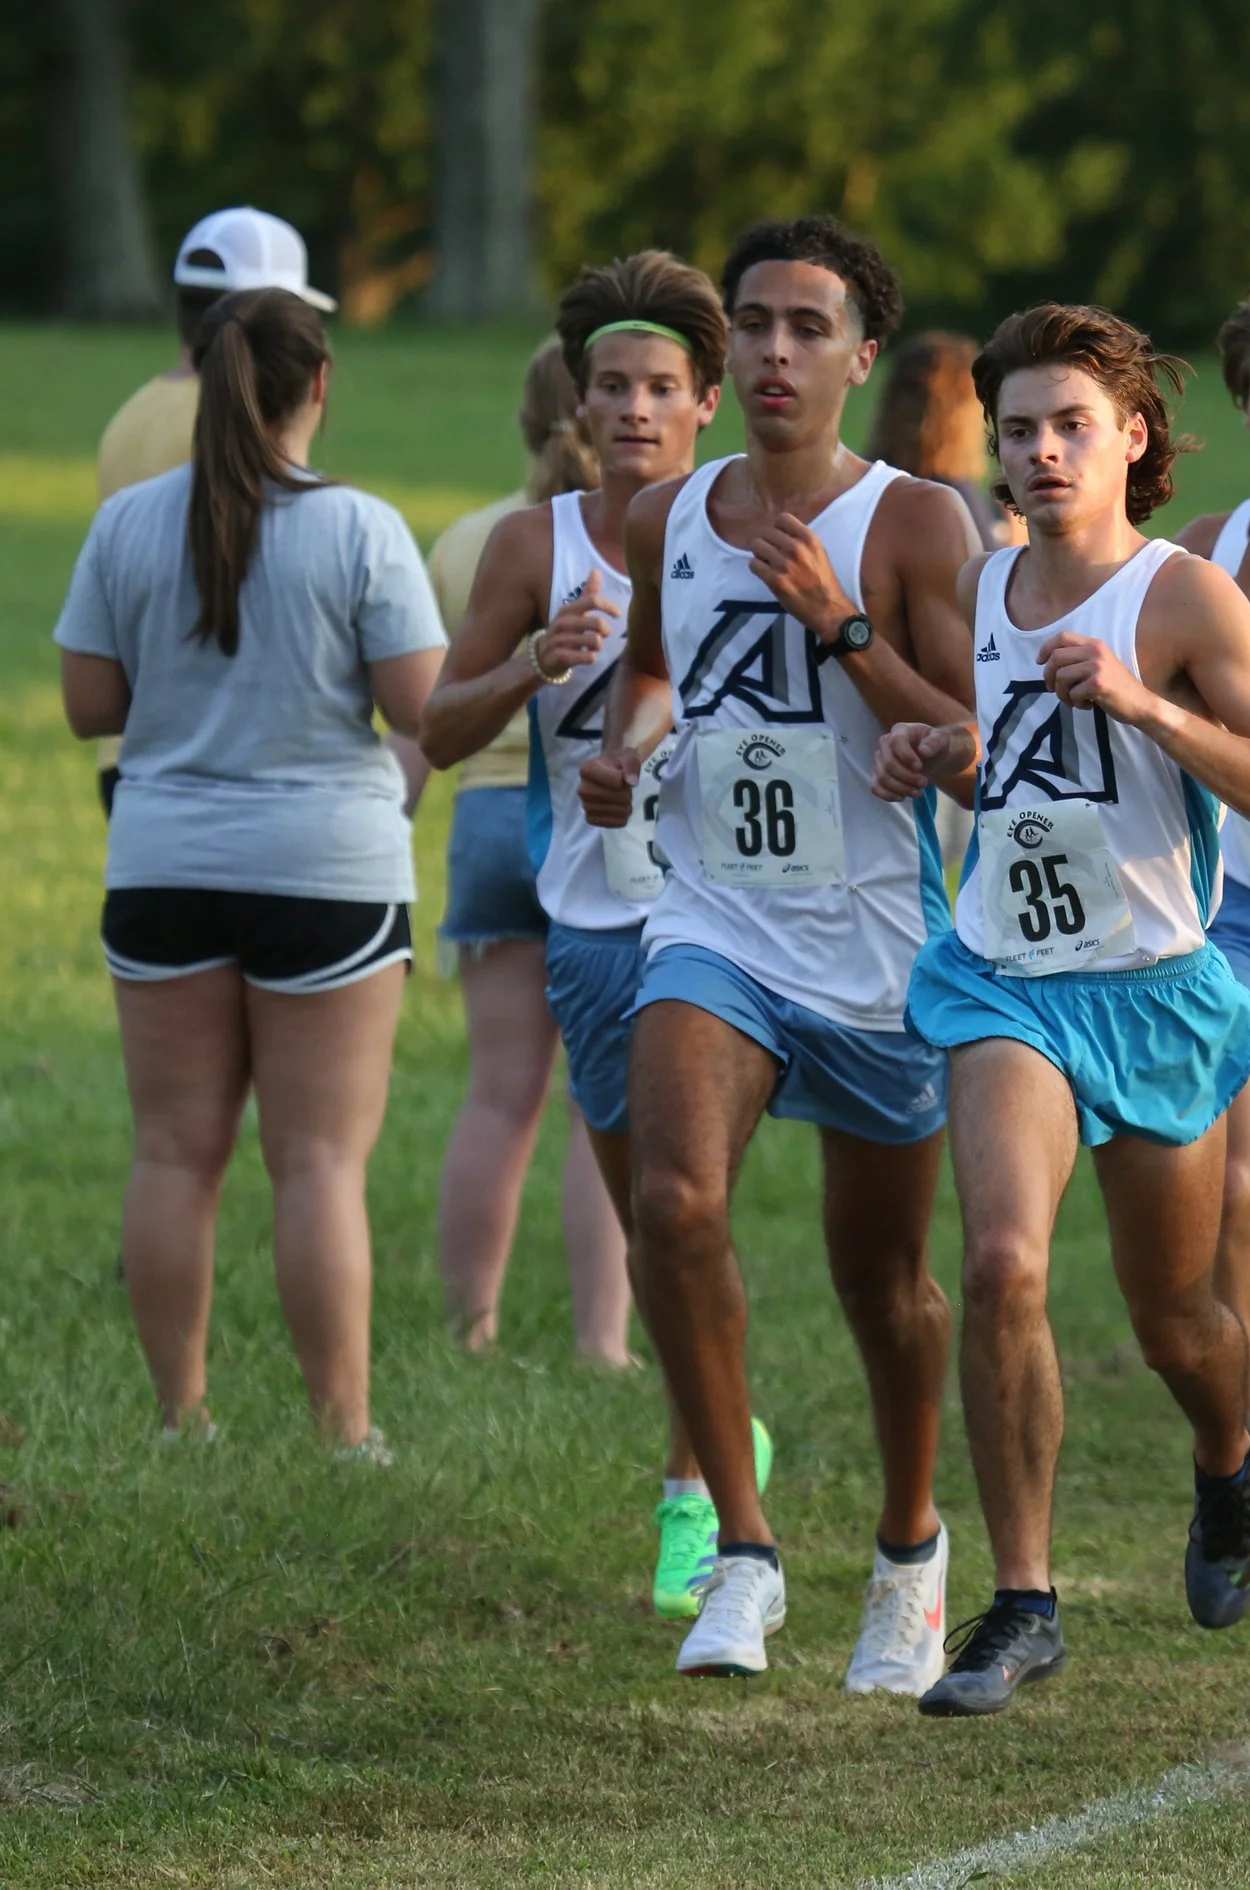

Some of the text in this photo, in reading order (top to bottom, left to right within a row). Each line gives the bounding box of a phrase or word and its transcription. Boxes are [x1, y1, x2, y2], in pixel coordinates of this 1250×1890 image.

[736, 734, 786, 757] EYE OPENER
[733, 779, 796, 857] 36
[1007, 811, 1055, 838] EYE OPENER
[1009, 854, 1086, 942] 35
[1005, 947, 1055, 963] FLEET FEET
